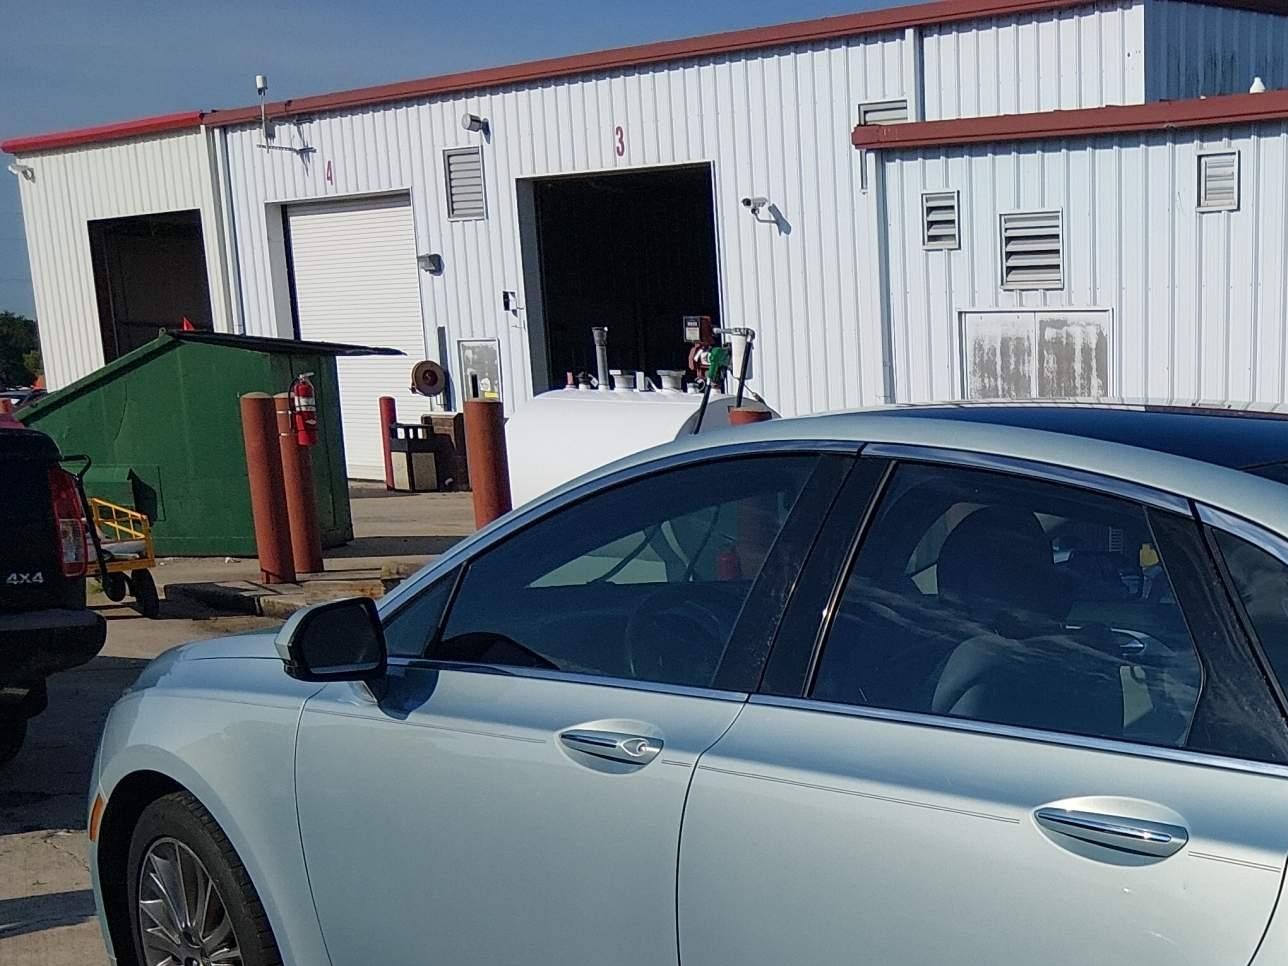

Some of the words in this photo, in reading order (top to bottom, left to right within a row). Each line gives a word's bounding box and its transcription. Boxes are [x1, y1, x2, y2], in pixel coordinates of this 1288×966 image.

[615, 126, 625, 157] 3
[326, 160, 334, 186] 4
[6, 571, 44, 584] 4X4
